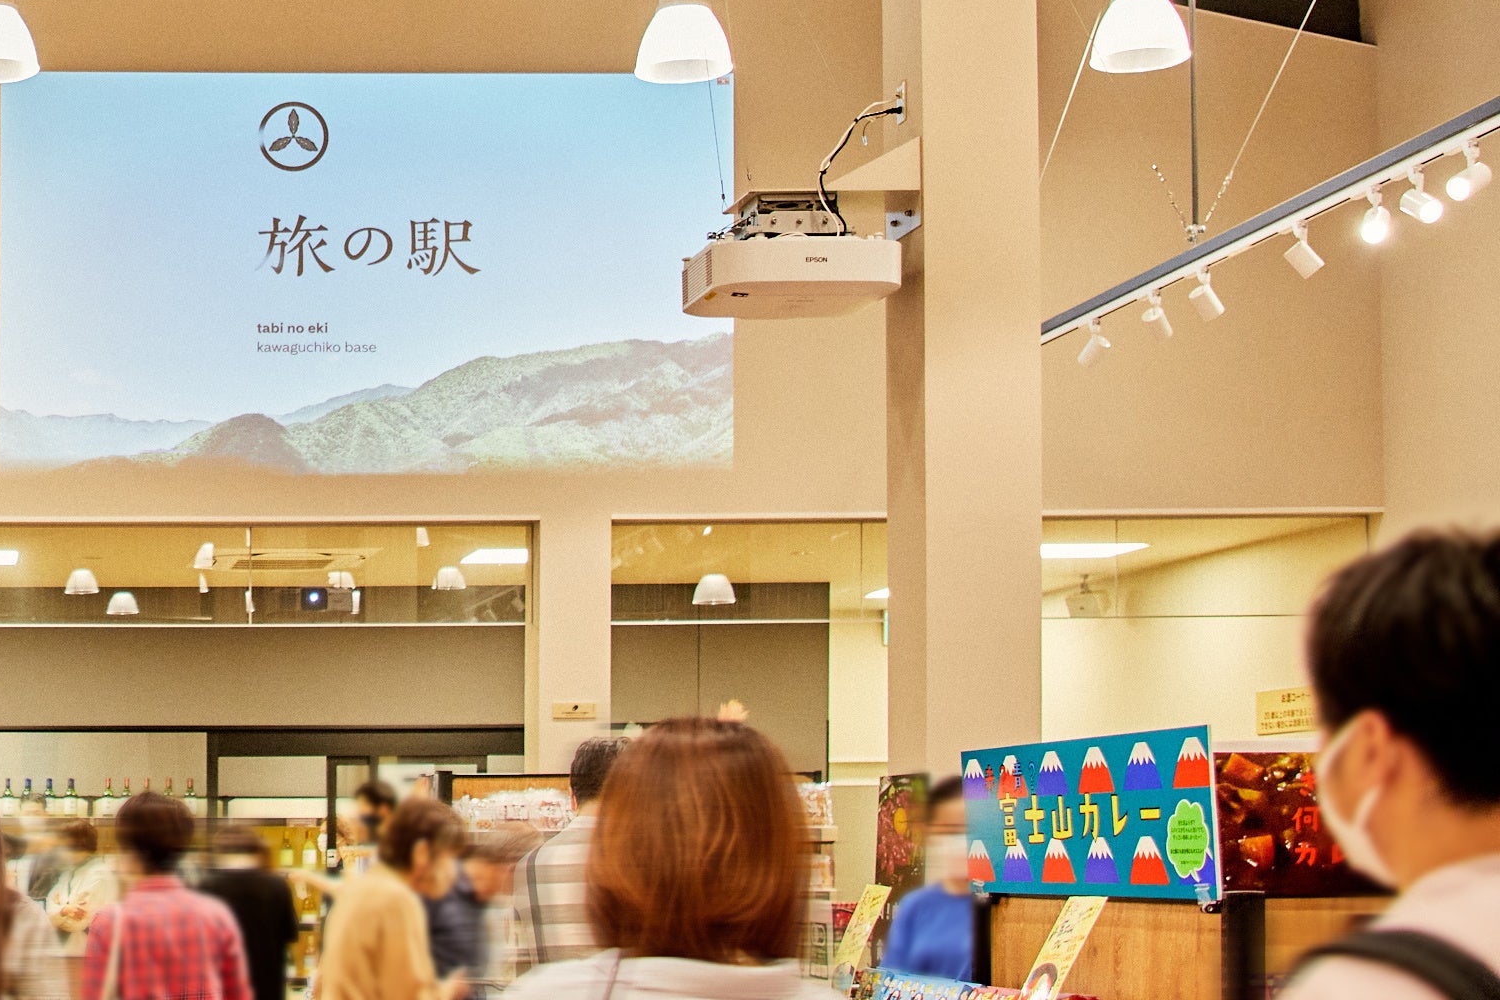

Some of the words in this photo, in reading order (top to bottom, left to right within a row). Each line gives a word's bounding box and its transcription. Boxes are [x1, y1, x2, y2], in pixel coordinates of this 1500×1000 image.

[255, 214, 481, 277] 旅の駅
[257, 322, 283, 334] tabi
[287, 325, 304, 334] no
[308, 322, 328, 334] eki
[257, 341, 341, 355] kawaguchiko
[345, 341, 377, 353] base
[999, 792, 1161, 847] 富士山カレー
[1292, 806, 1320, 832] 何
